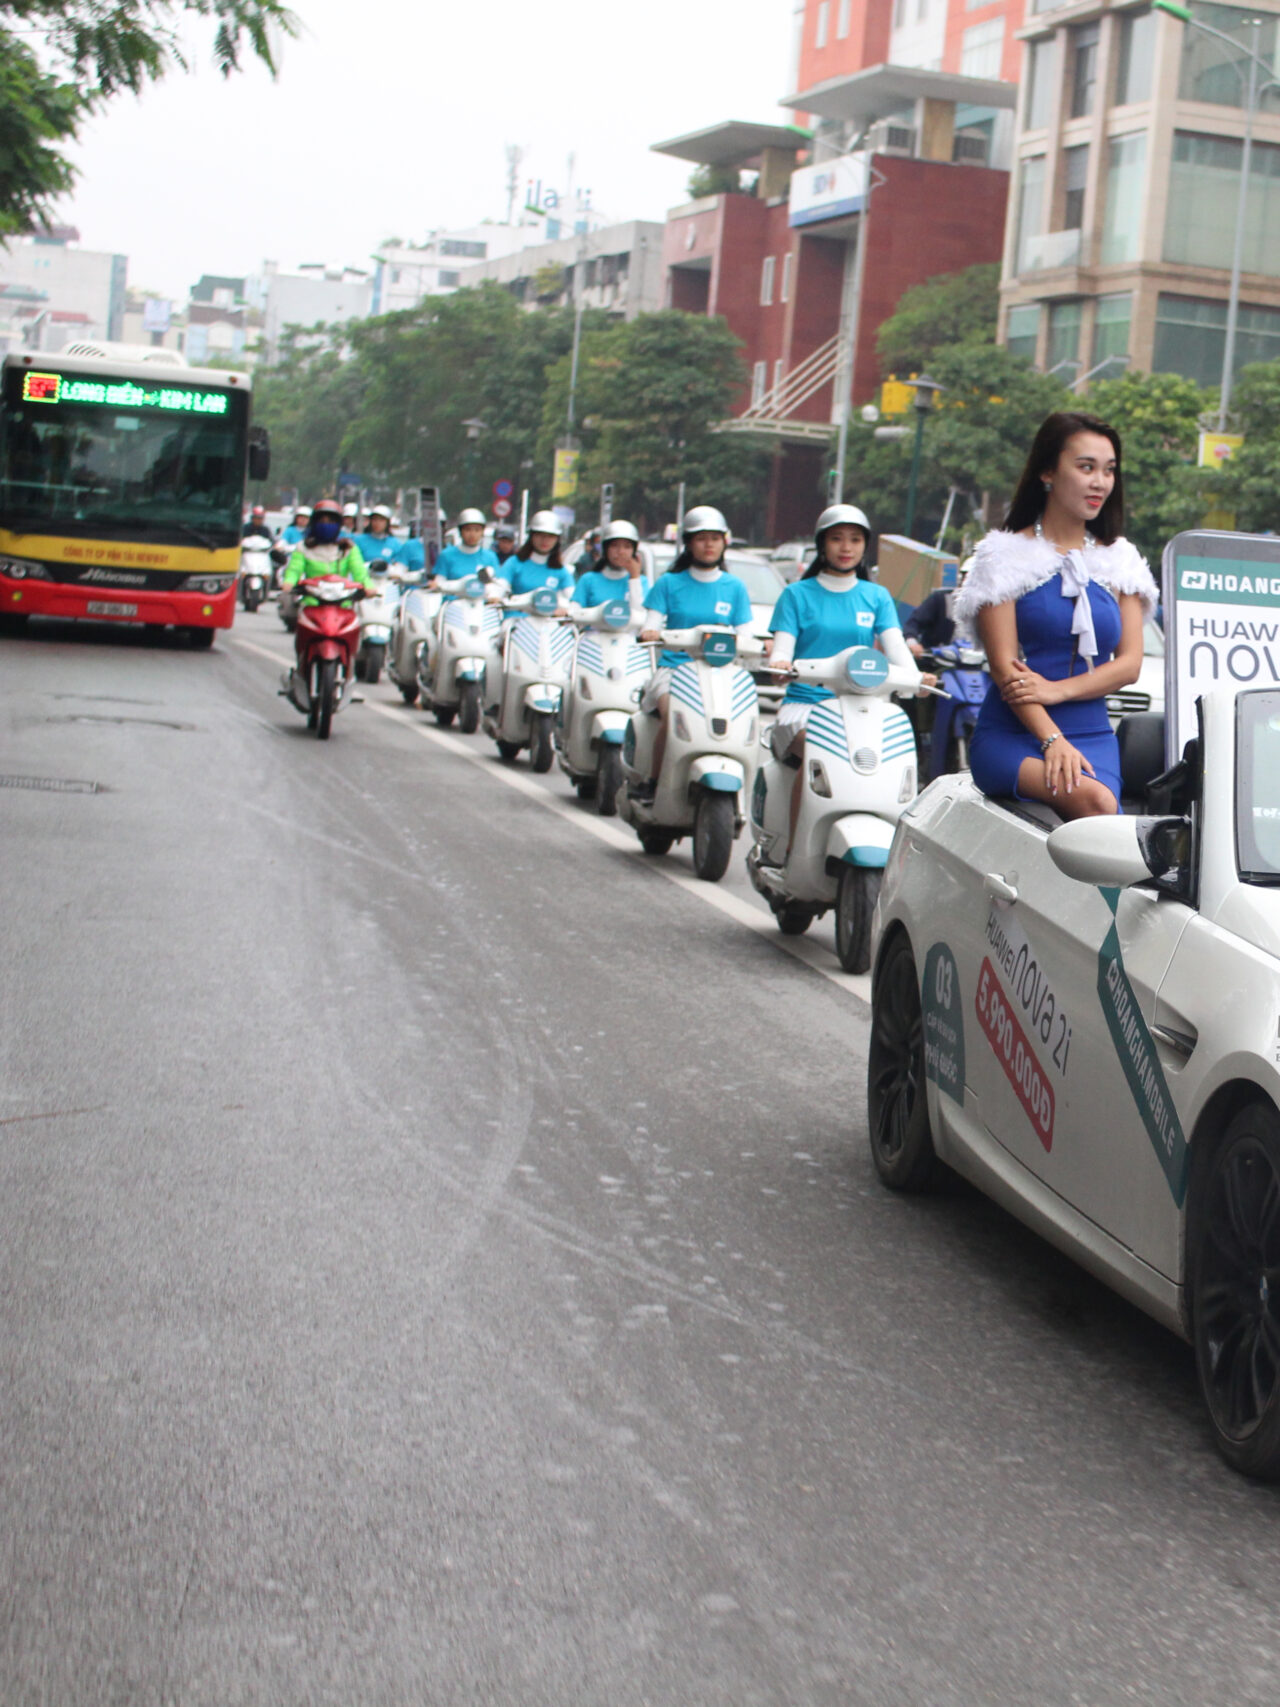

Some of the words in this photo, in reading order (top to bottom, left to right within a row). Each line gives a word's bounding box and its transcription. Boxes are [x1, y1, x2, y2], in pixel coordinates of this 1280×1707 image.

[935, 954, 952, 1011] 03
[984, 910, 1016, 980] HUAWEI
[1012, 943, 1056, 1045] nova
[1112, 978, 1177, 1157] HOANGHAMOBILE
